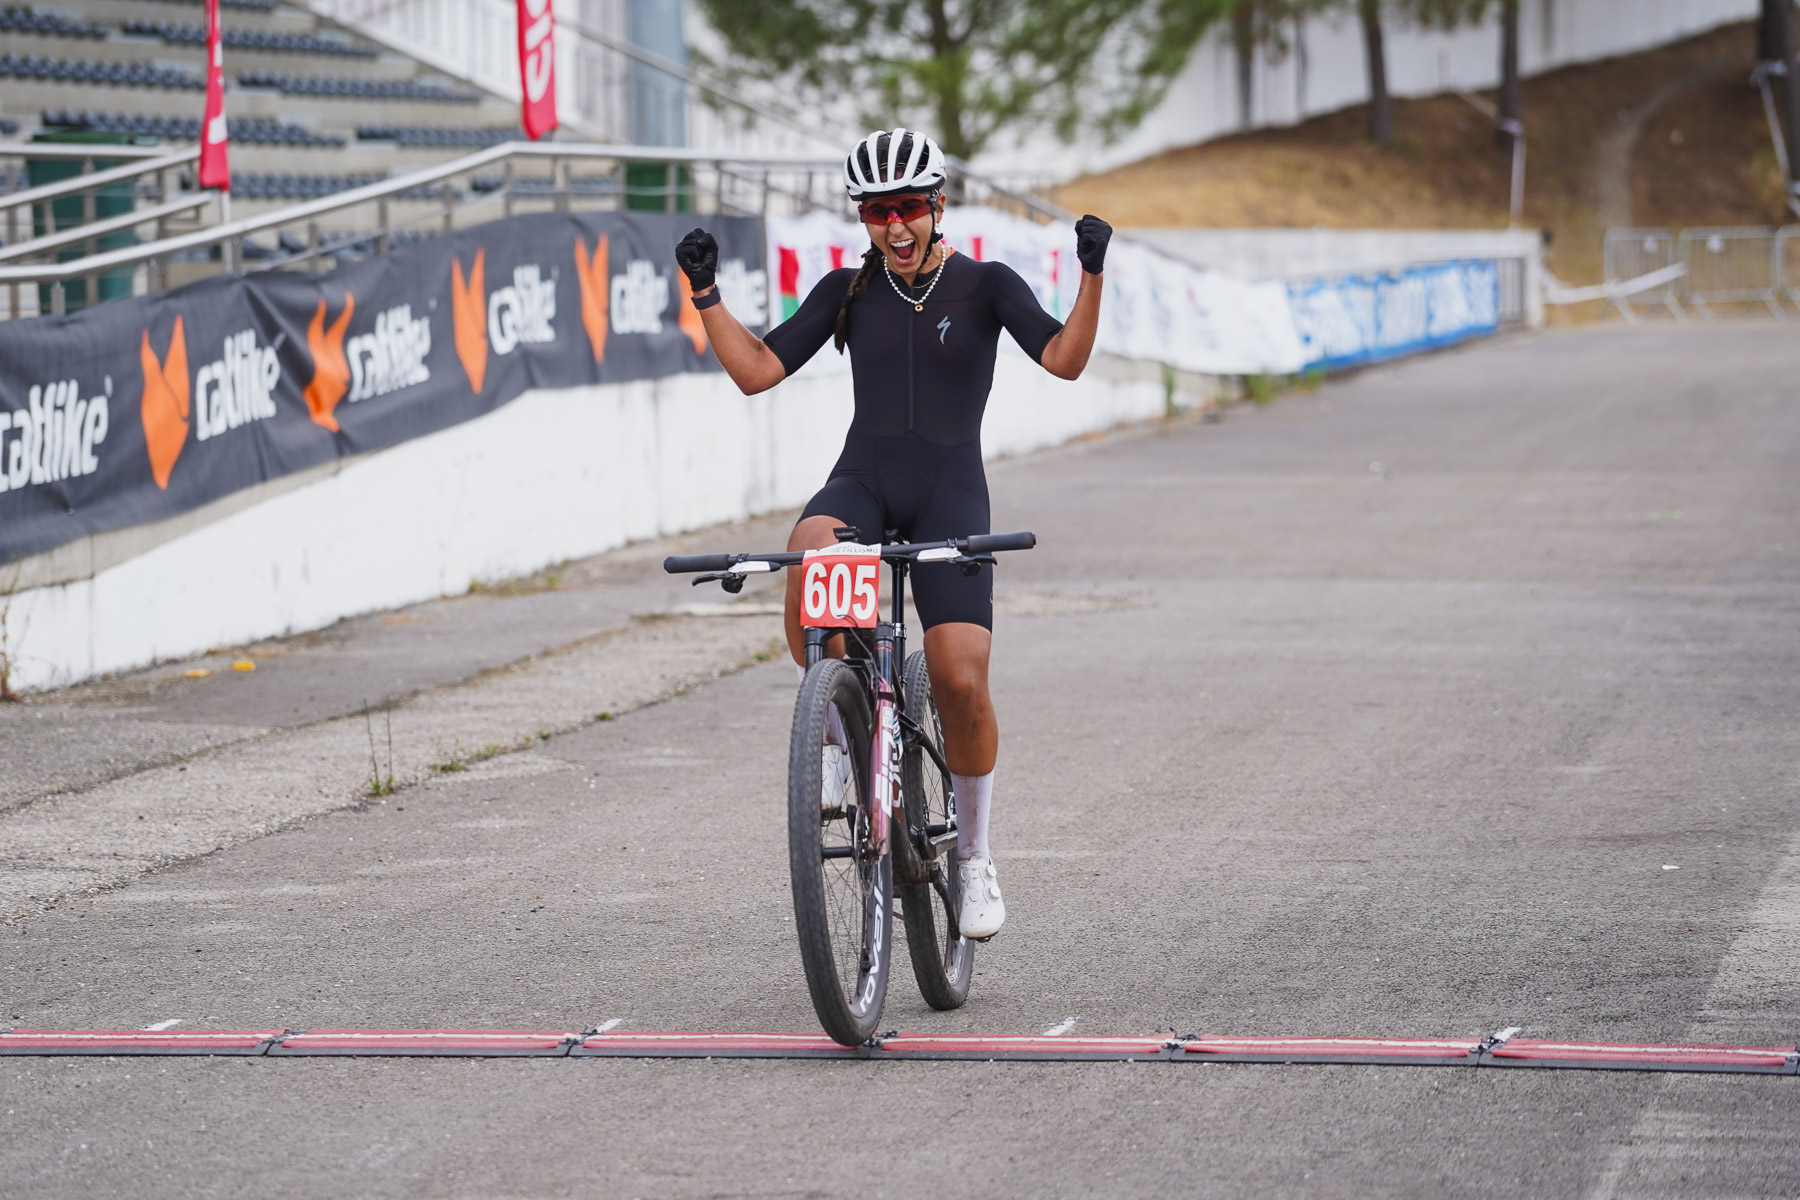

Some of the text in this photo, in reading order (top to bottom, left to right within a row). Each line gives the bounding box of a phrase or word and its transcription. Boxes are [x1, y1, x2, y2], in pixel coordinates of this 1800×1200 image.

[0, 379, 109, 492] catlike
[196, 328, 281, 441] catlike
[804, 562, 876, 620] 605
[859, 886, 884, 1012] roval
